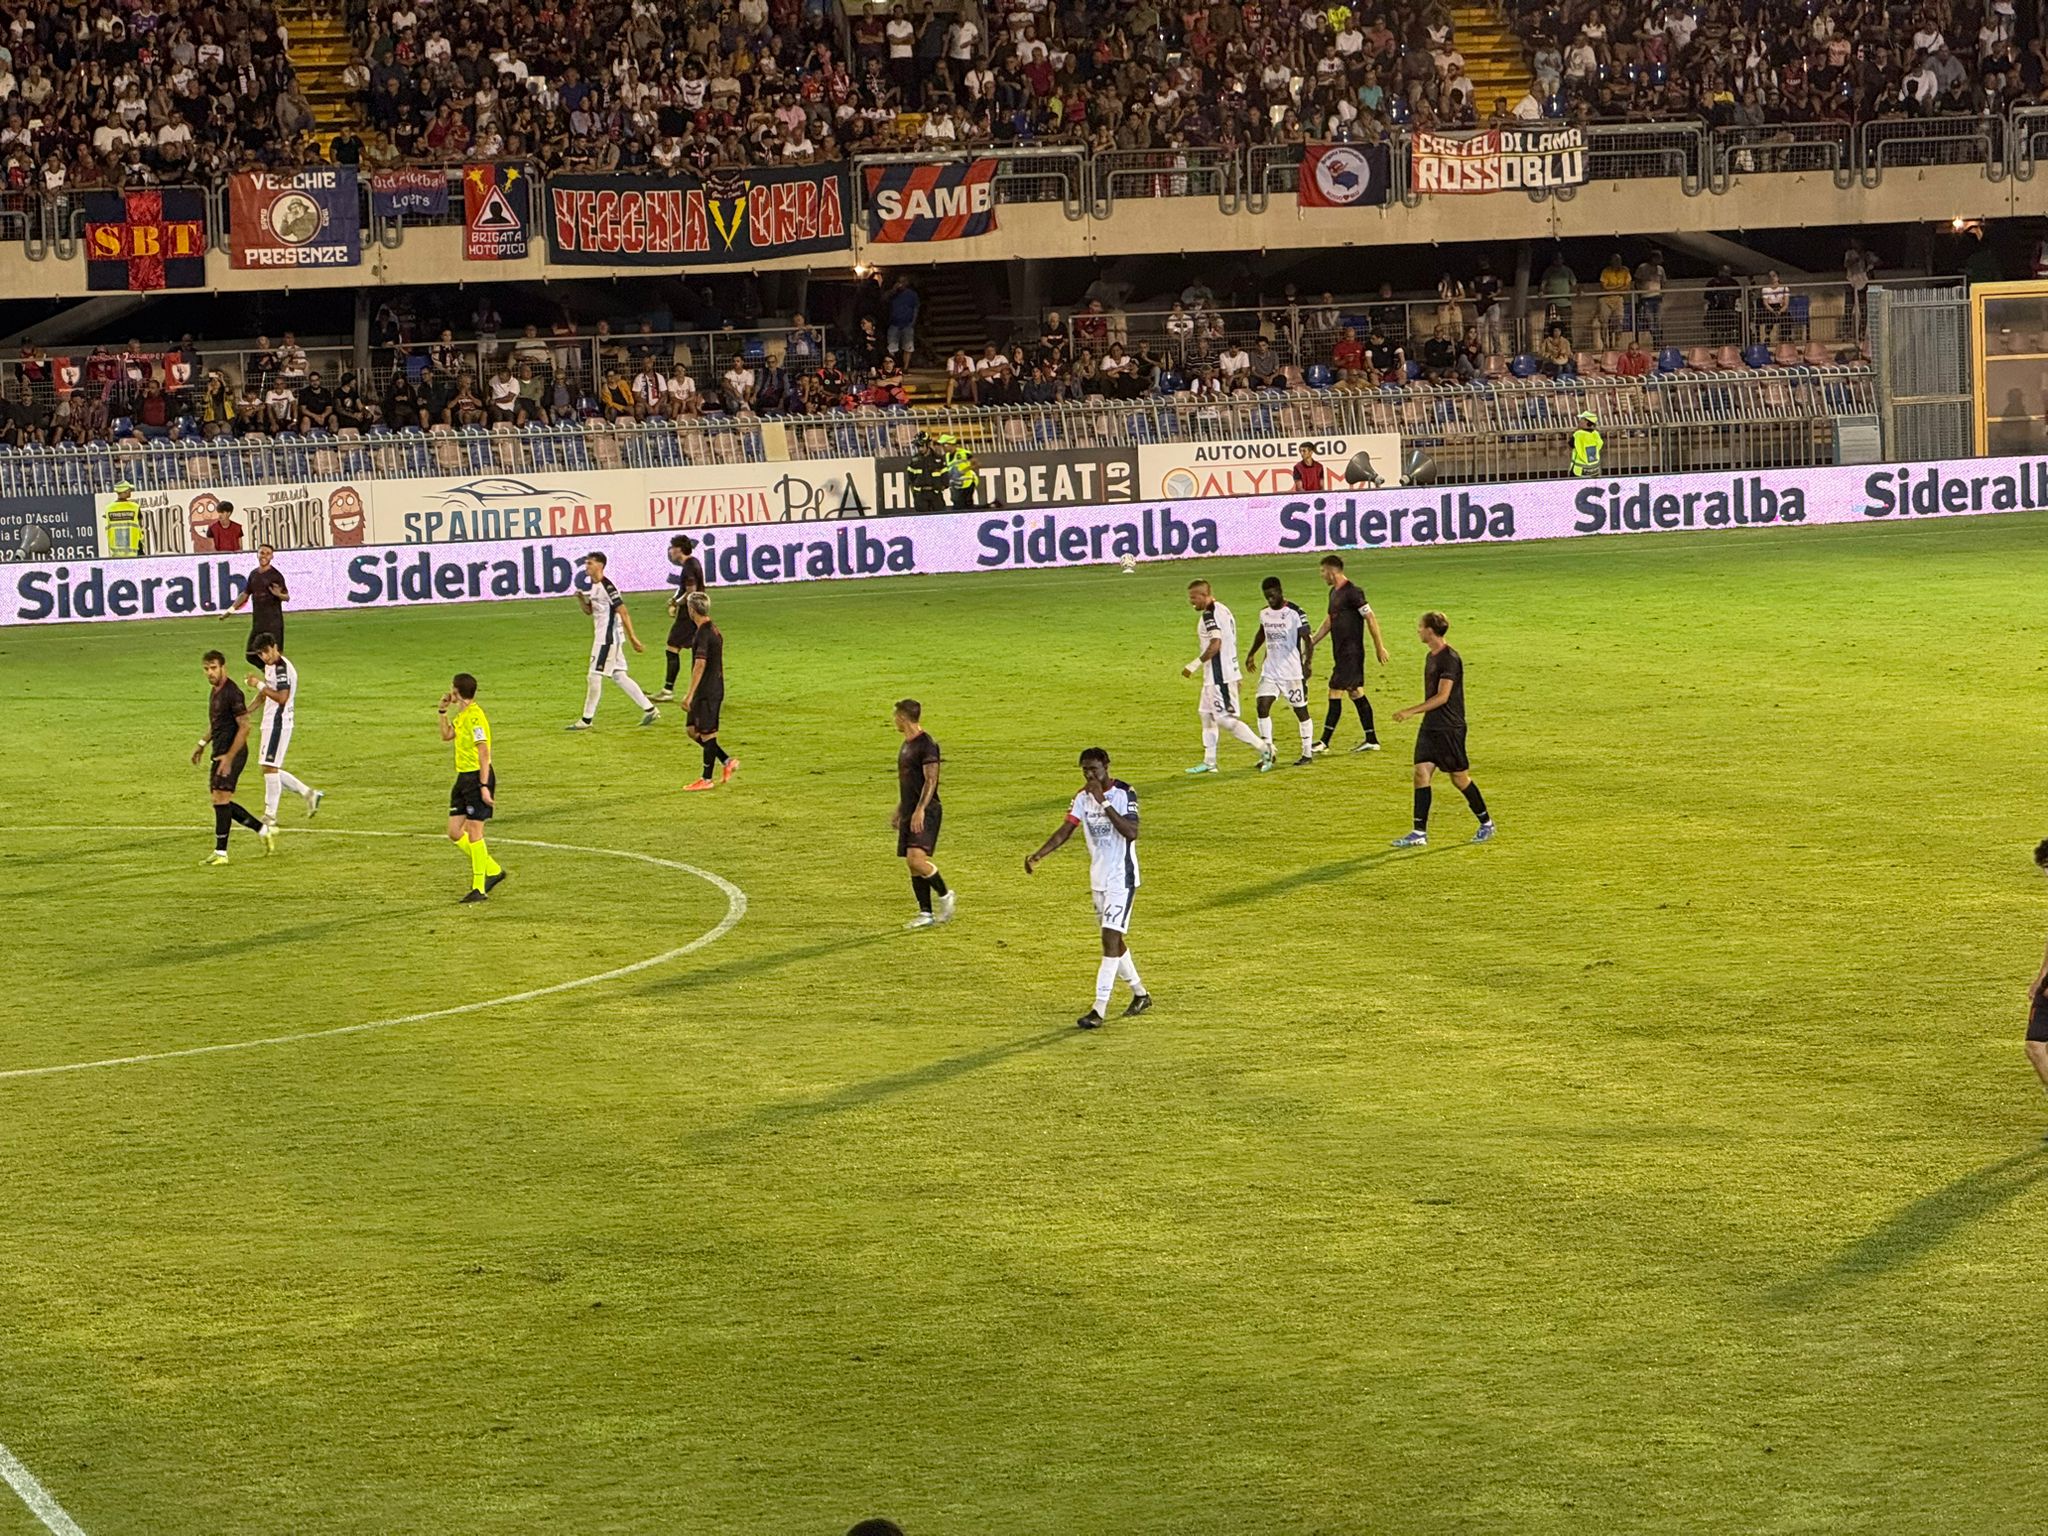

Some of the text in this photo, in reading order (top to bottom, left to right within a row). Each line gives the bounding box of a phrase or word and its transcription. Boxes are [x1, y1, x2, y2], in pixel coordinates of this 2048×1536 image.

[1419, 128, 1582, 156] CASTEL DI LAMA
[1418, 151, 1583, 190] ROSSOBLU
[392, 193, 430, 209] Loers
[552, 188, 710, 253] VECCHIA
[749, 176, 844, 247] ONDA
[877, 182, 991, 221] SAMB
[94, 224, 197, 257] SBT
[471, 231, 521, 243] BRIGATA
[244, 246, 348, 266] PRESENZE
[1195, 440, 1347, 461] AUTONOLEGIO
[883, 463, 1097, 509] HTBEAT
[25, 512, 69, 524] D'Ascoli
[649, 491, 771, 527] PIZZERIA
[1278, 492, 1516, 549] Sideralba
[1574, 477, 1807, 532] Sideralba
[76, 526, 93, 537] 100
[404, 503, 614, 543] SPAIDER CAR
[977, 508, 1219, 566] Sideralba
[17, 561, 249, 620] Sideralb
[347, 545, 592, 603] Sideralba
[1288, 689, 1303, 703] 23
[1104, 904, 1124, 923] 47
